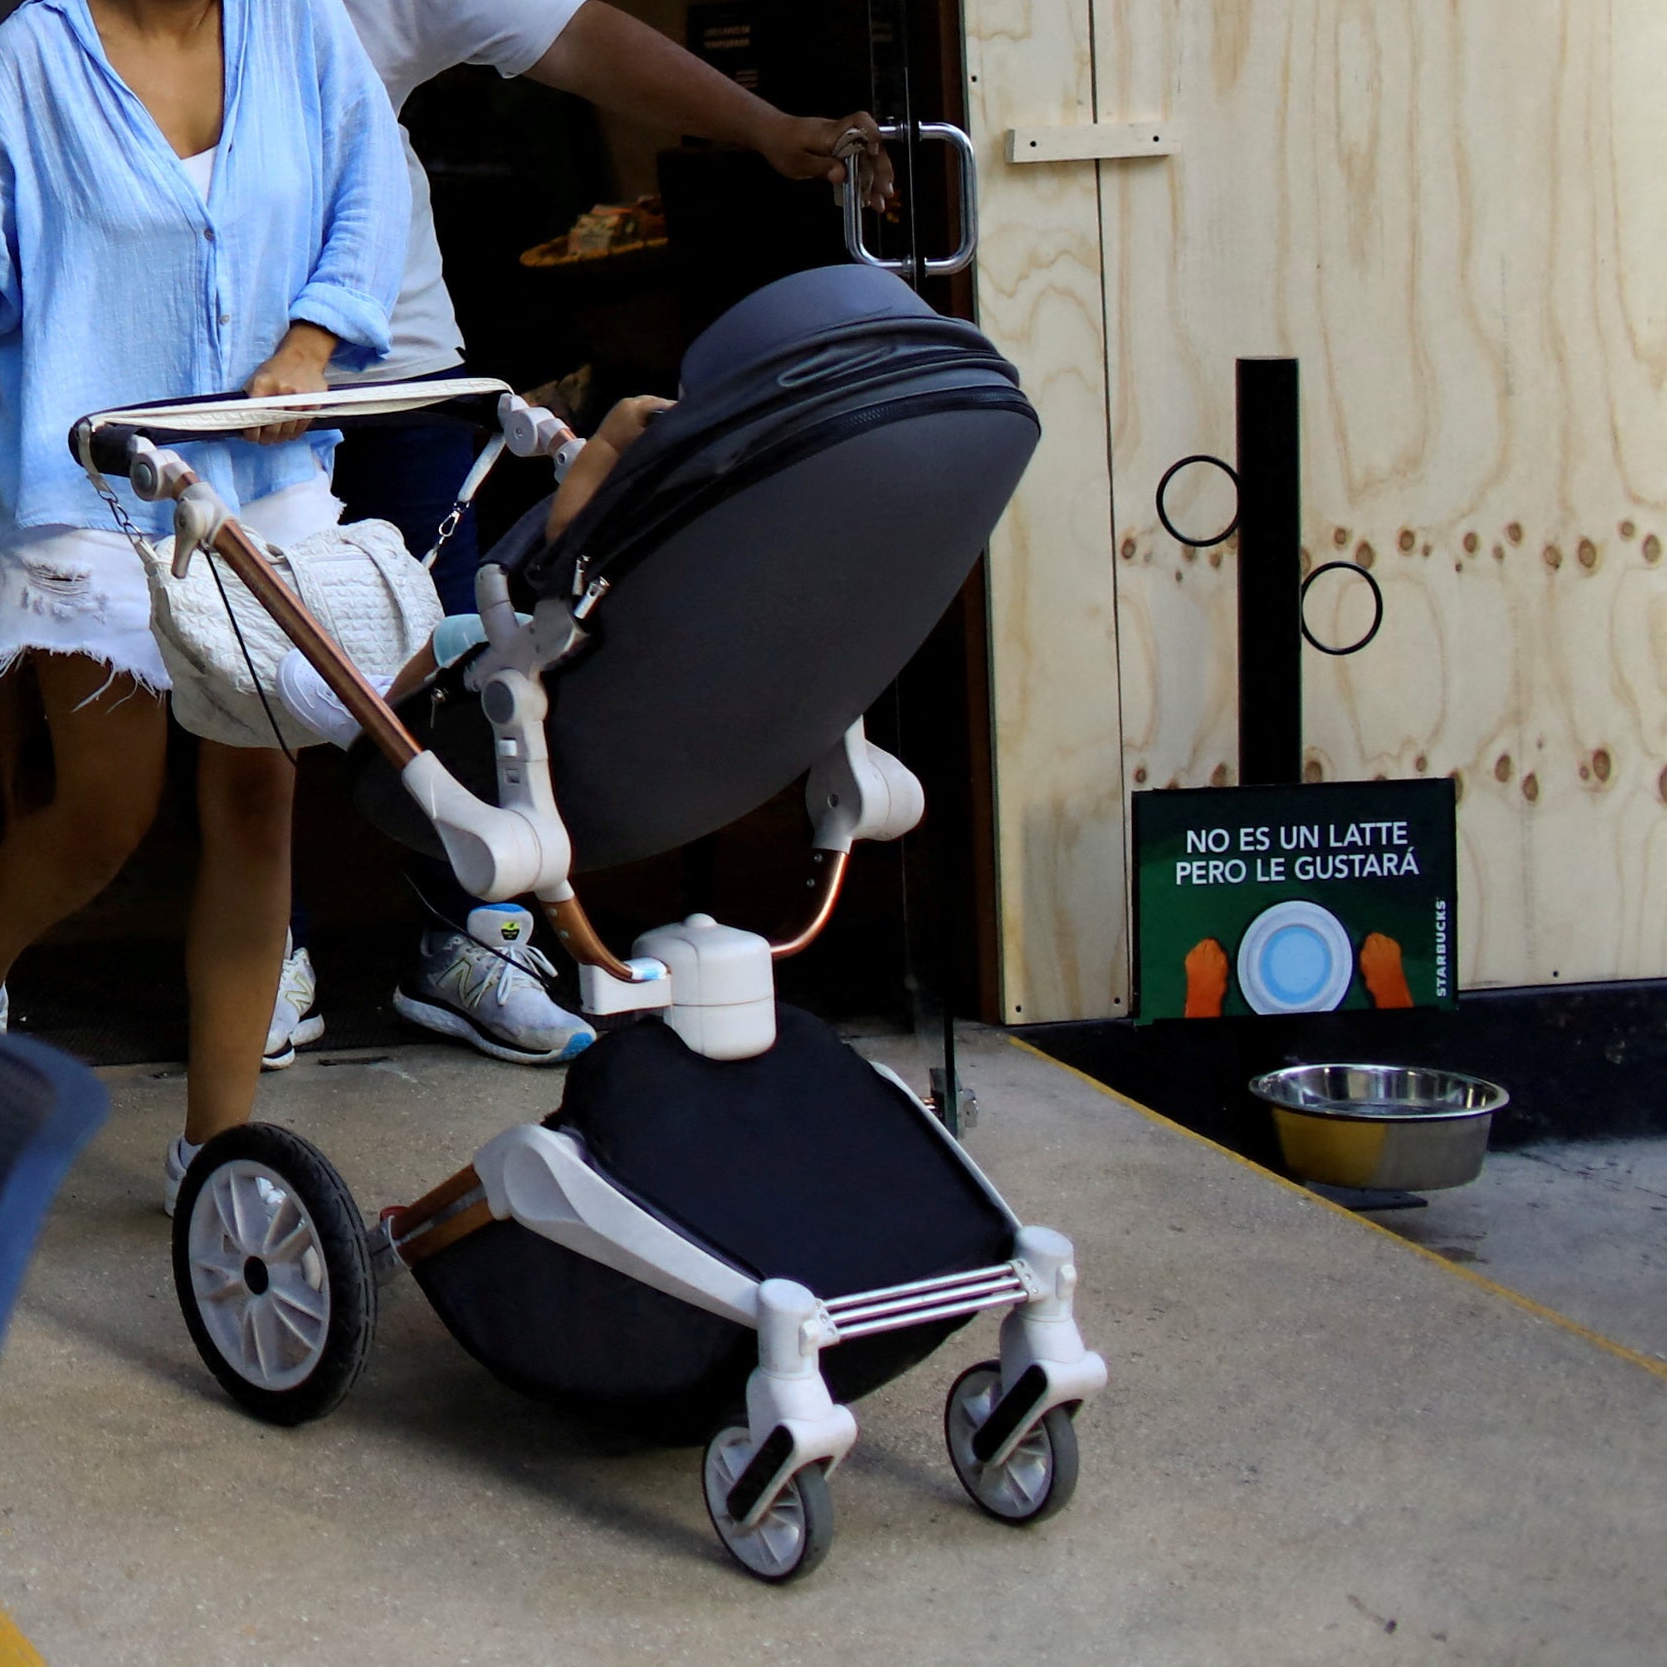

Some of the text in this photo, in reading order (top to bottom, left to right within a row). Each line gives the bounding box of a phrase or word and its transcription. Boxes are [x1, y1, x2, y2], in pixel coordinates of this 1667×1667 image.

[1185, 820, 1409, 854] NO ES UN LATTE
[1175, 846, 1420, 886] PERO LE GUSTARÁ
[1434, 899, 1447, 998] STARBUCKS
